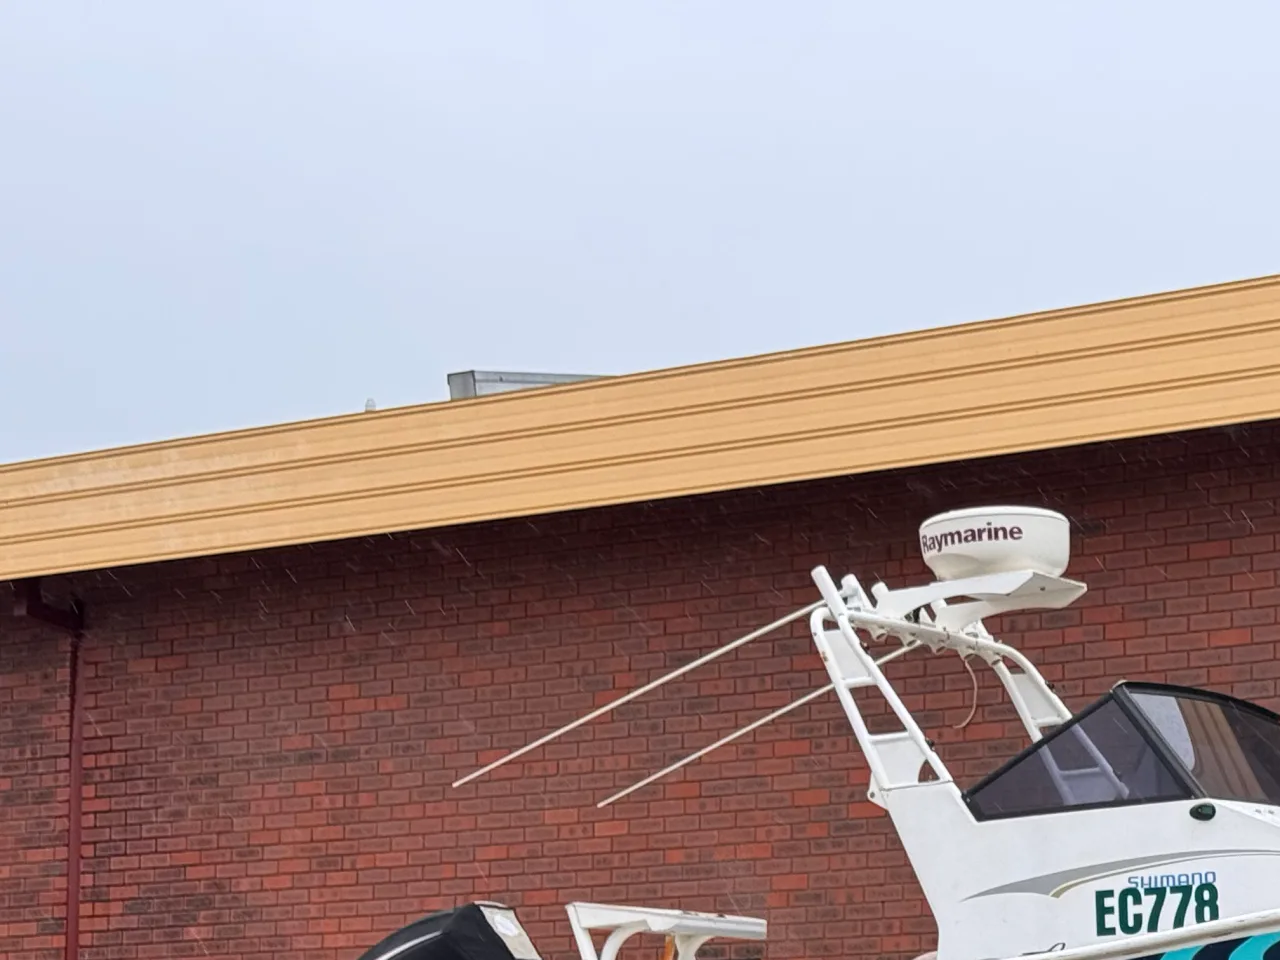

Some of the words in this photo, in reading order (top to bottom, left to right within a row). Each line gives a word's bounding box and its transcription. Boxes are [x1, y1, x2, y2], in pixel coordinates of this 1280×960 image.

[922, 521, 1023, 554] Raymarine
[1128, 871, 1217, 888] SHIMANO
[1095, 883, 1220, 937] EC778
